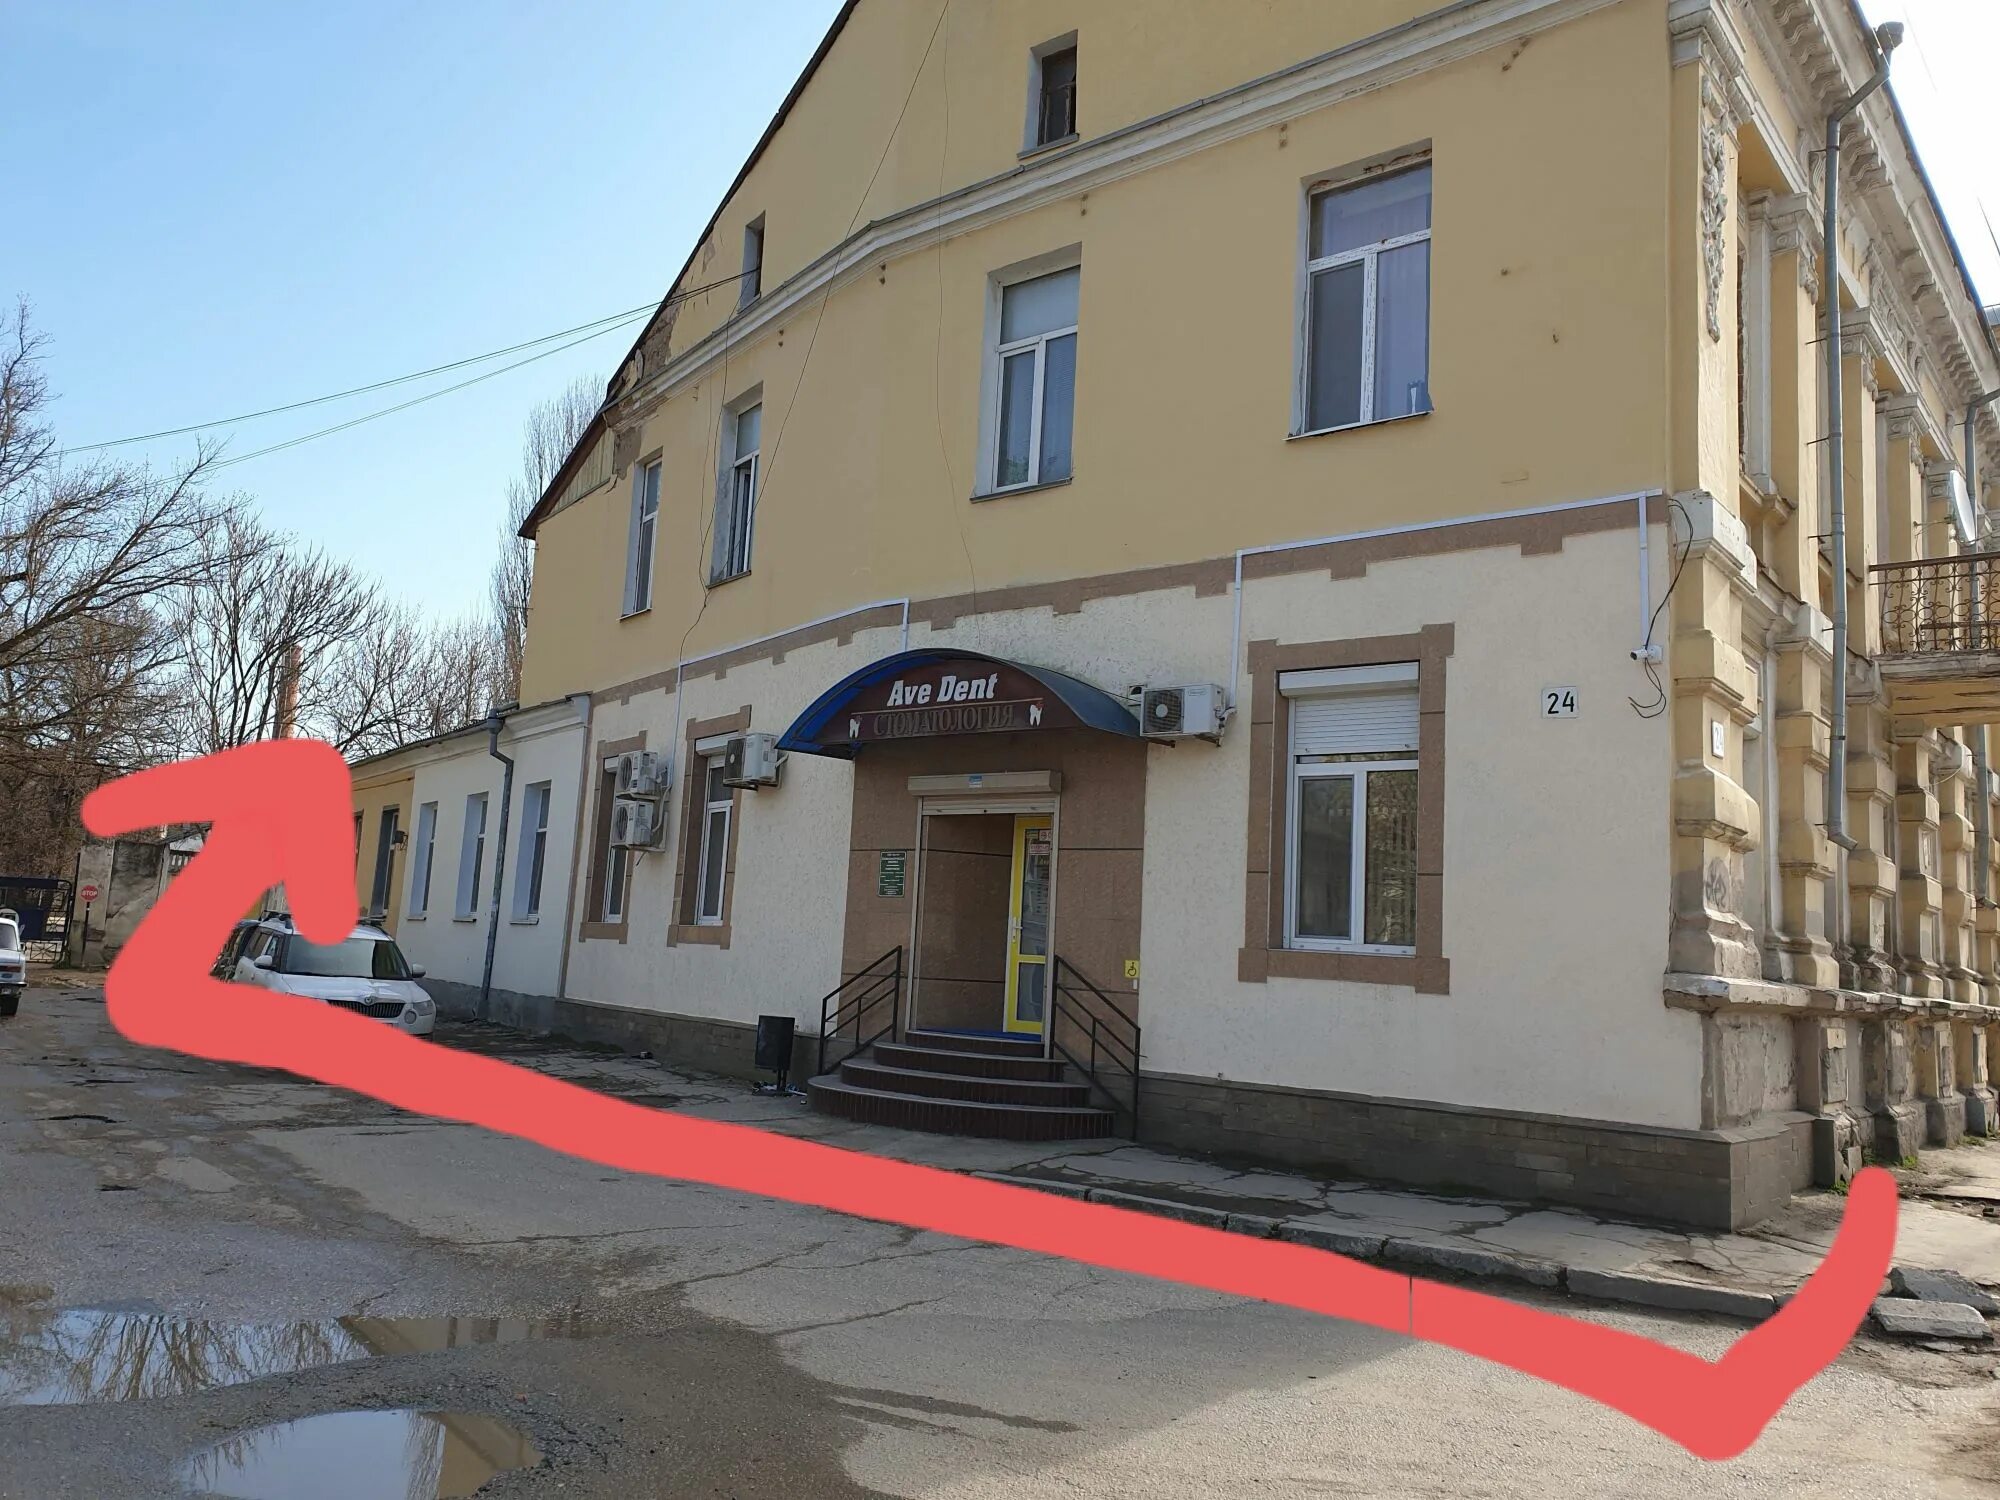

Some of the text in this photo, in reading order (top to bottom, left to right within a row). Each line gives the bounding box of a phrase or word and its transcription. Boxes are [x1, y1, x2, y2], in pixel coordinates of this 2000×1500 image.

[887, 673, 998, 707] Ave Dent
[1547, 690, 1574, 715] 24
[873, 704, 1016, 737] СТОМАТОЛОГИЯ
[81, 889, 97, 897] STOP
